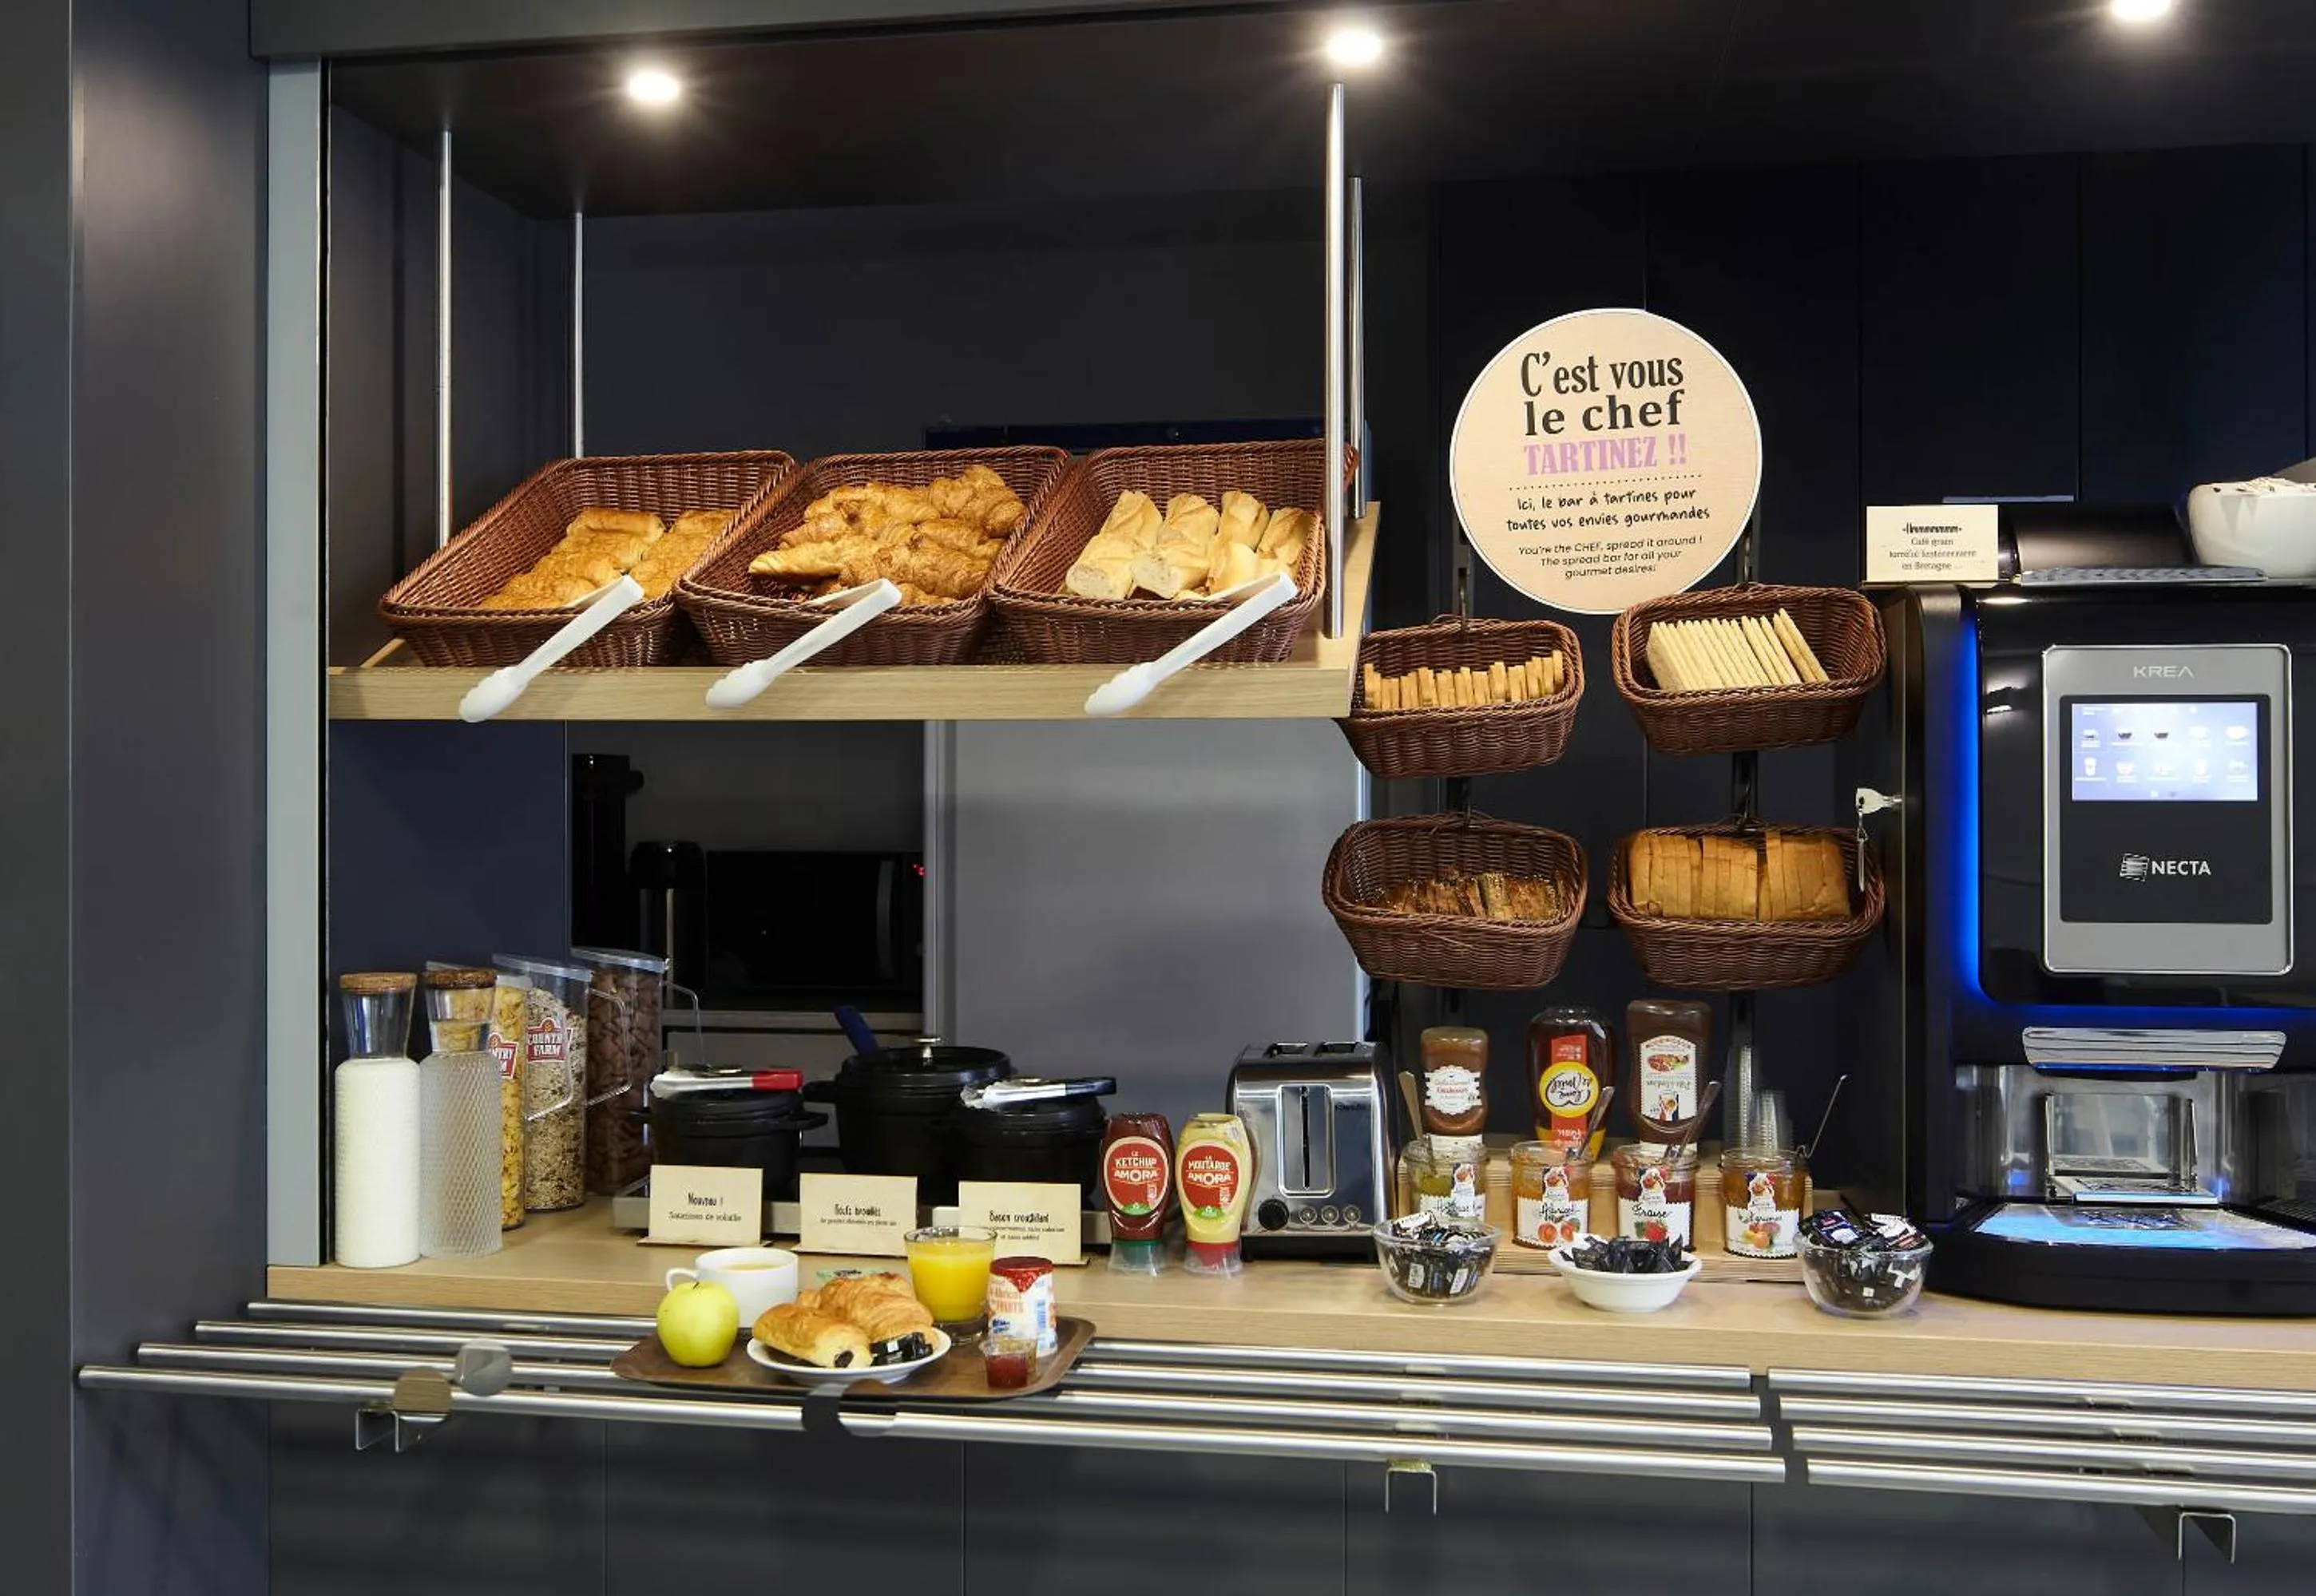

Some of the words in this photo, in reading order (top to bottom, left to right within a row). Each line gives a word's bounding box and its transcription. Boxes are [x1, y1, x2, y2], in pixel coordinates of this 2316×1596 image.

[1521, 351, 1600, 397] C'est
[1608, 358, 1683, 390] vous
[1524, 401, 1565, 436] le
[1582, 389, 1685, 431] chef
[1523, 436, 1658, 475] TARTINEZ
[1517, 498, 1536, 511] Ici,
[1542, 497, 1553, 509] le
[1559, 493, 1584, 507] bar
[1589, 491, 1599, 505] à
[1604, 490, 1658, 505] tartines
[1664, 488, 1697, 504] pour
[1507, 518, 1547, 532] toutes
[1552, 517, 1573, 528] vos
[1579, 513, 1619, 527] envies
[1624, 506, 1711, 527] gourmandes
[1554, 545, 1572, 553] the
[1607, 540, 1644, 551] spread
[1647, 539, 1653, 548] it
[1656, 537, 1695, 546] around
[1562, 554, 1602, 567] spread
[1604, 553, 1622, 562] bar
[1641, 550, 1655, 560] all
[1657, 550, 1682, 562] your
[1565, 567, 1612, 580] gourmet
[2151, 861, 2211, 875] NECTA
[1115, 1157, 1157, 1168] KETCHUP
[1188, 1159, 1231, 1170] MOUTARDE
[1114, 1169, 1158, 1182] AMORA
[1188, 1171, 1231, 1186] AMORA
